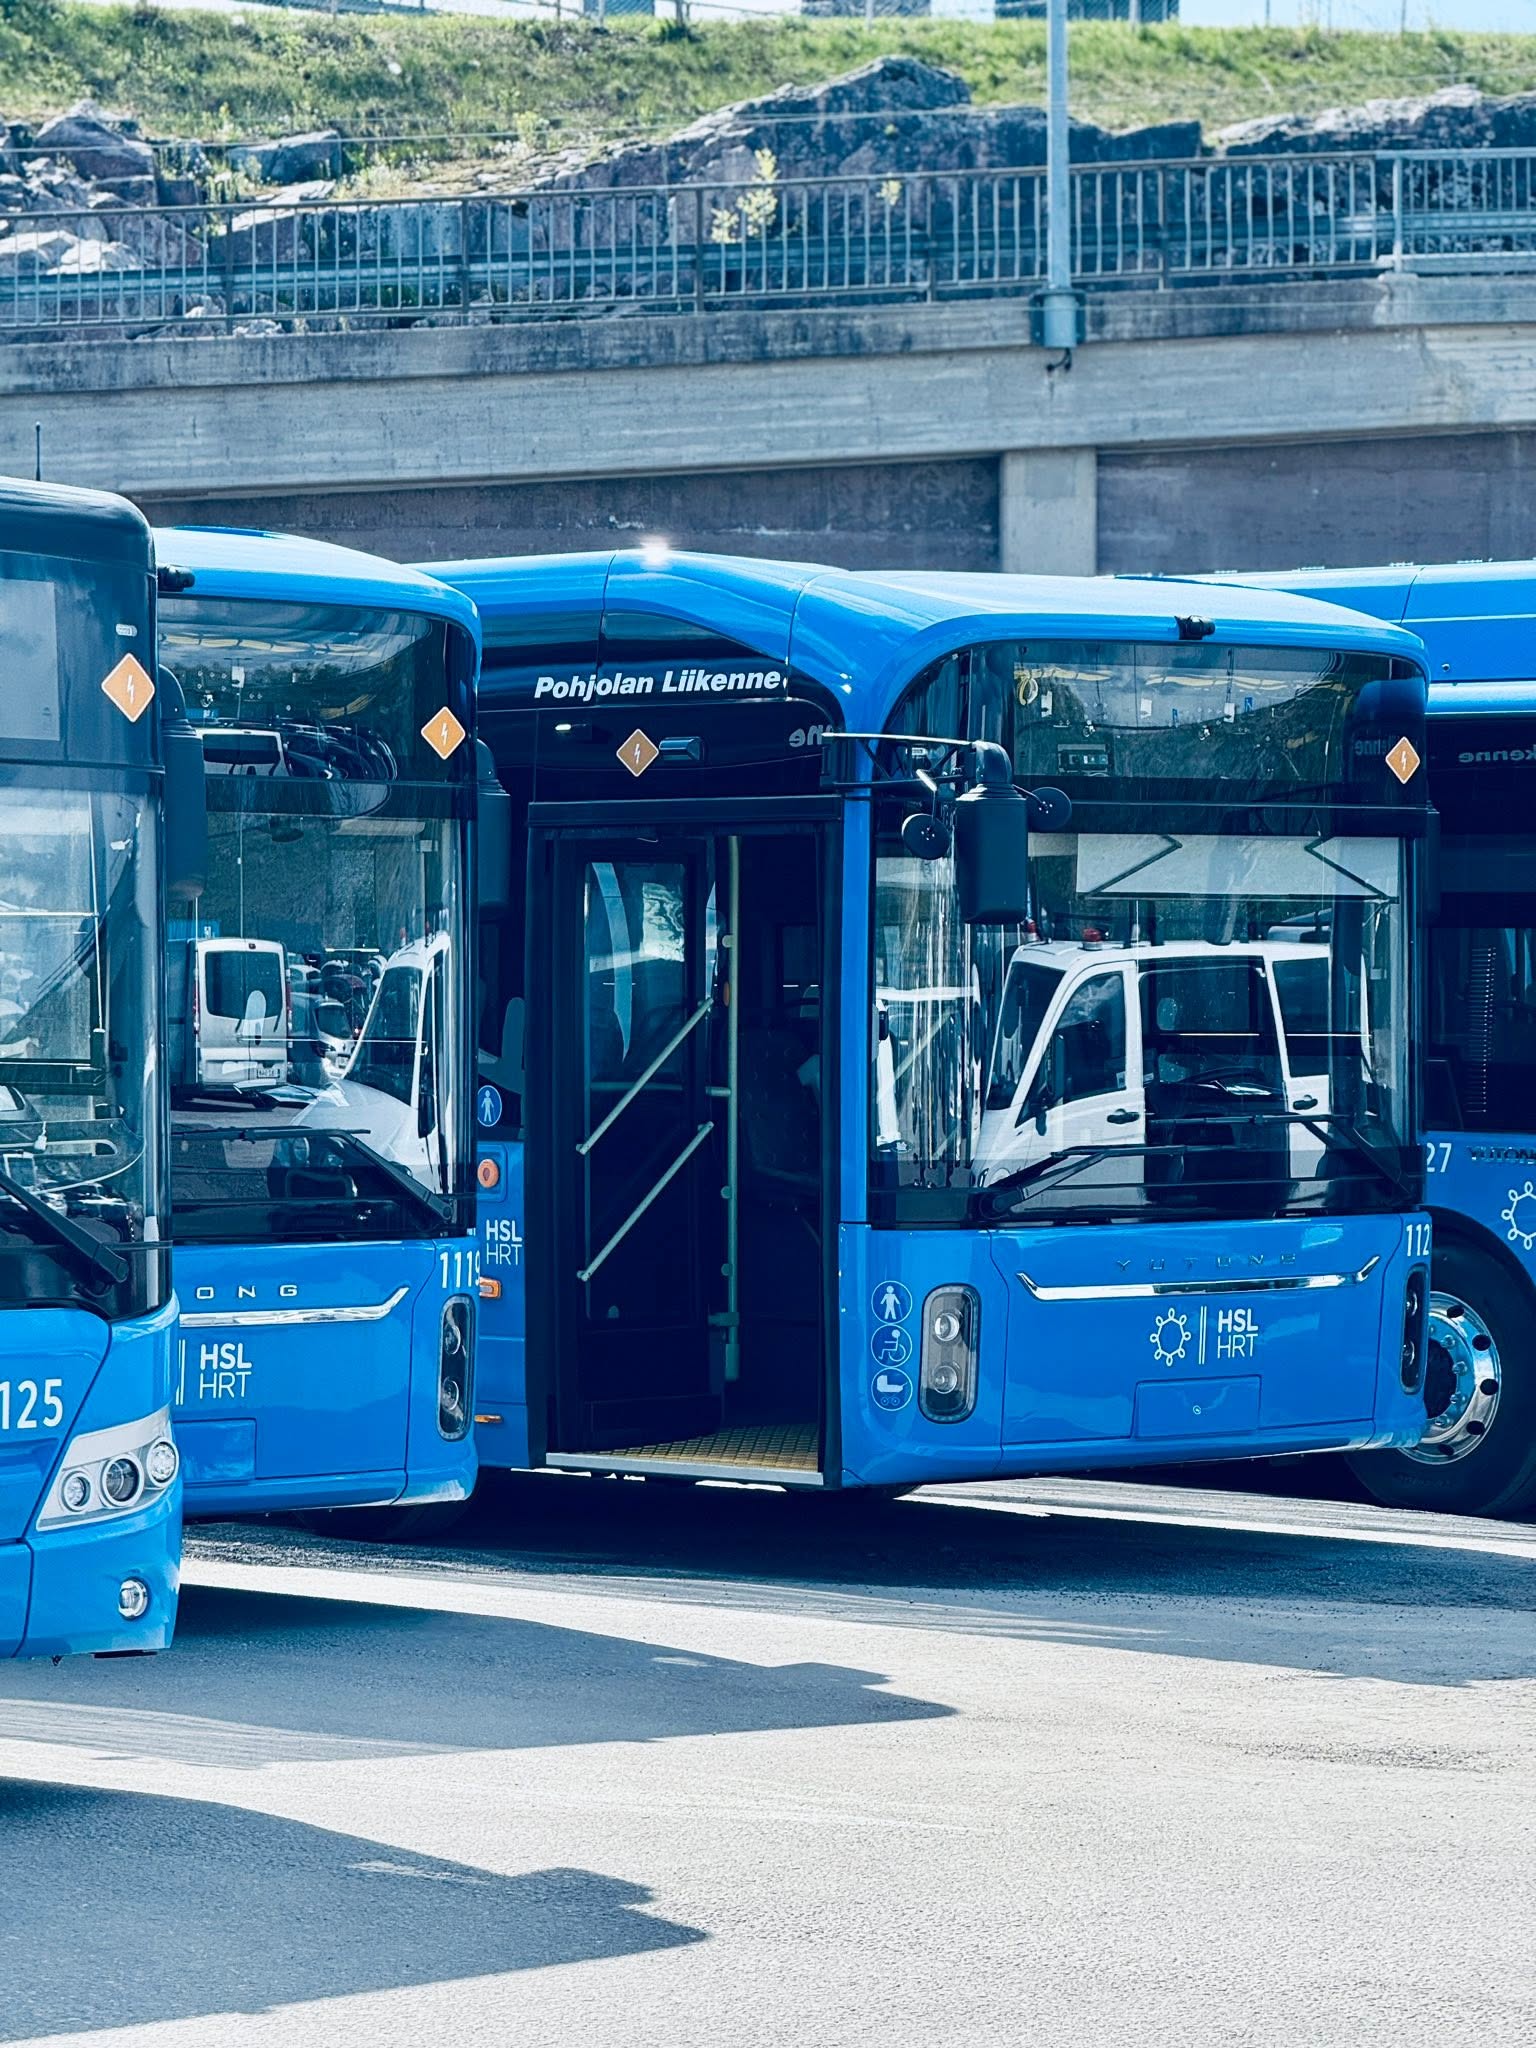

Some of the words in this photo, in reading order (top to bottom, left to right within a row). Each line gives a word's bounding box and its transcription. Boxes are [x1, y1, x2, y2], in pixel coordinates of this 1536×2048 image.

[535, 673, 653, 701] Pohjolan
[662, 669, 781, 693] Liikenne
[486, 1219, 522, 1242] HSL
[486, 1243, 522, 1265] HRT
[1218, 1308, 1258, 1333] HSL
[201, 1342, 252, 1370] HSL
[1217, 1333, 1258, 1359] HRT
[200, 1371, 252, 1399] HRT
